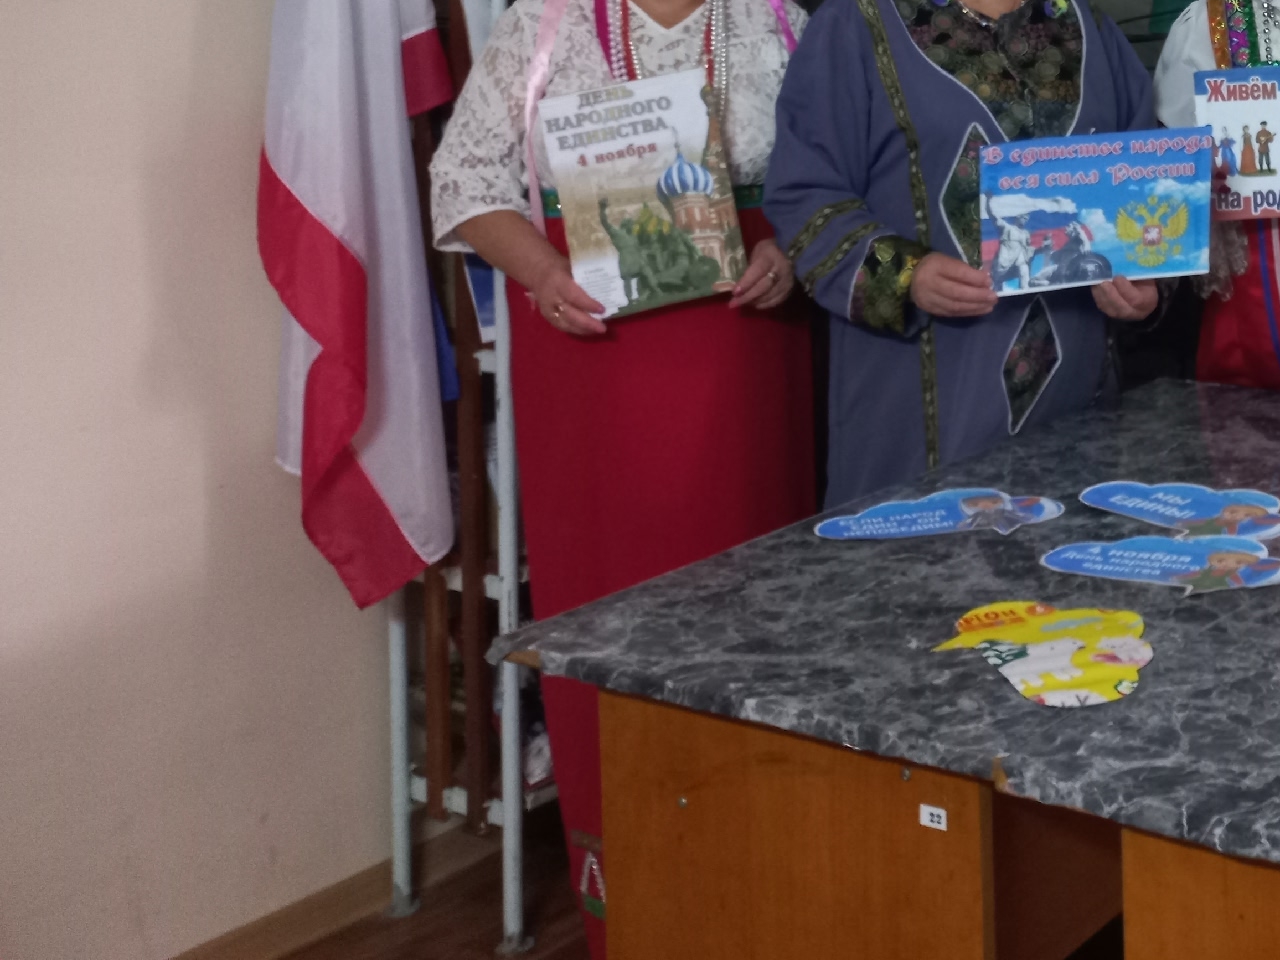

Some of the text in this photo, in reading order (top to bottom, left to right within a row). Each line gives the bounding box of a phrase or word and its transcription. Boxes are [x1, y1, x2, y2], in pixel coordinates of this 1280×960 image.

[577, 85, 635, 108] ДЕНЬ
[1205, 77, 1278, 103] Живём
[544, 96, 673, 134] НАРОДНОГО
[556, 116, 669, 151] ЕДИНСТВА
[576, 142, 658, 167] 4 ноября
[1010, 140, 1124, 167] единстве
[1130, 135, 1213, 157] народа
[999, 162, 1196, 190] вся сила России
[1215, 190, 1243, 212] на
